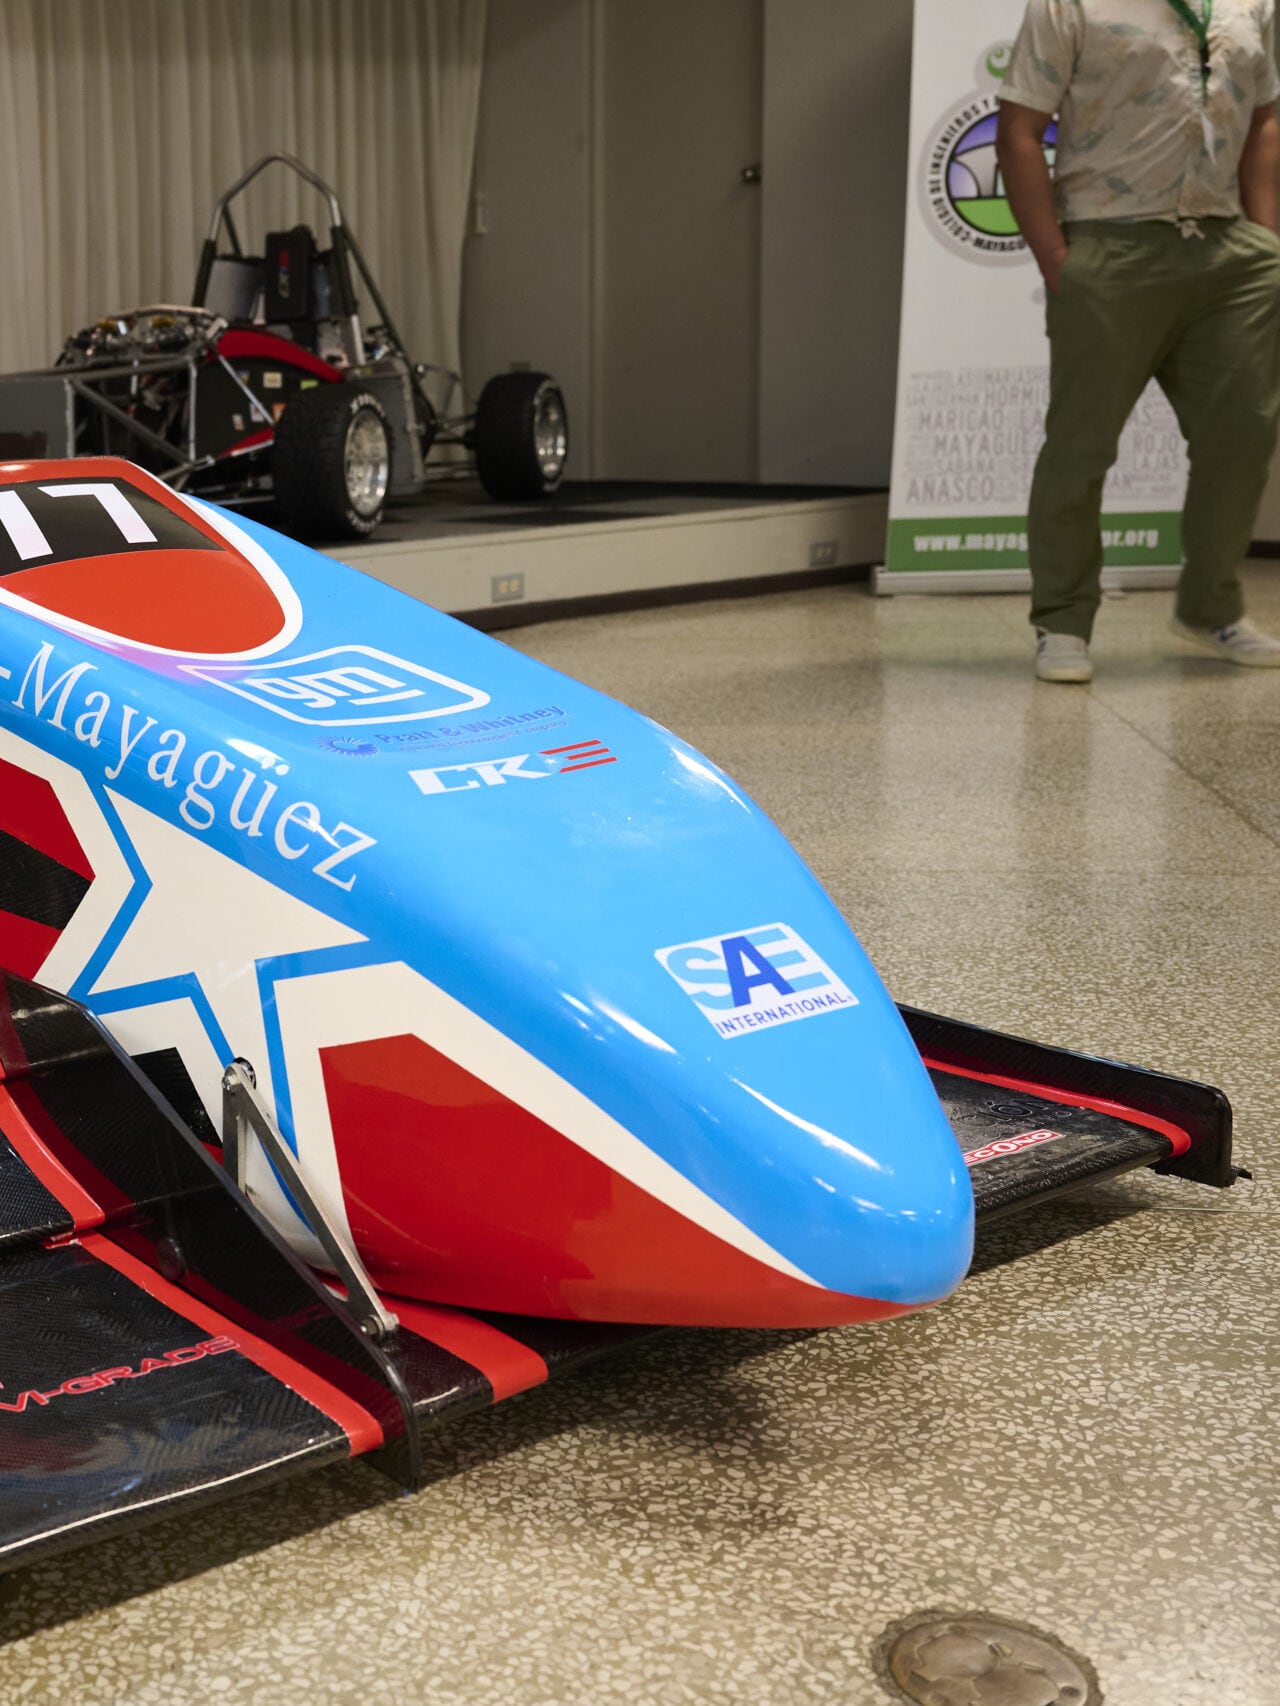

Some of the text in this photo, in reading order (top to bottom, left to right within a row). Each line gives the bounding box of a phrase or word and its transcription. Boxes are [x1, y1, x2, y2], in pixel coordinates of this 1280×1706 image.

[374, 728, 439, 745] Pratt
[458, 703, 567, 735] Whitney
[666, 927, 832, 1011] SAE
[715, 992, 848, 1035] INTERNATIONAL
